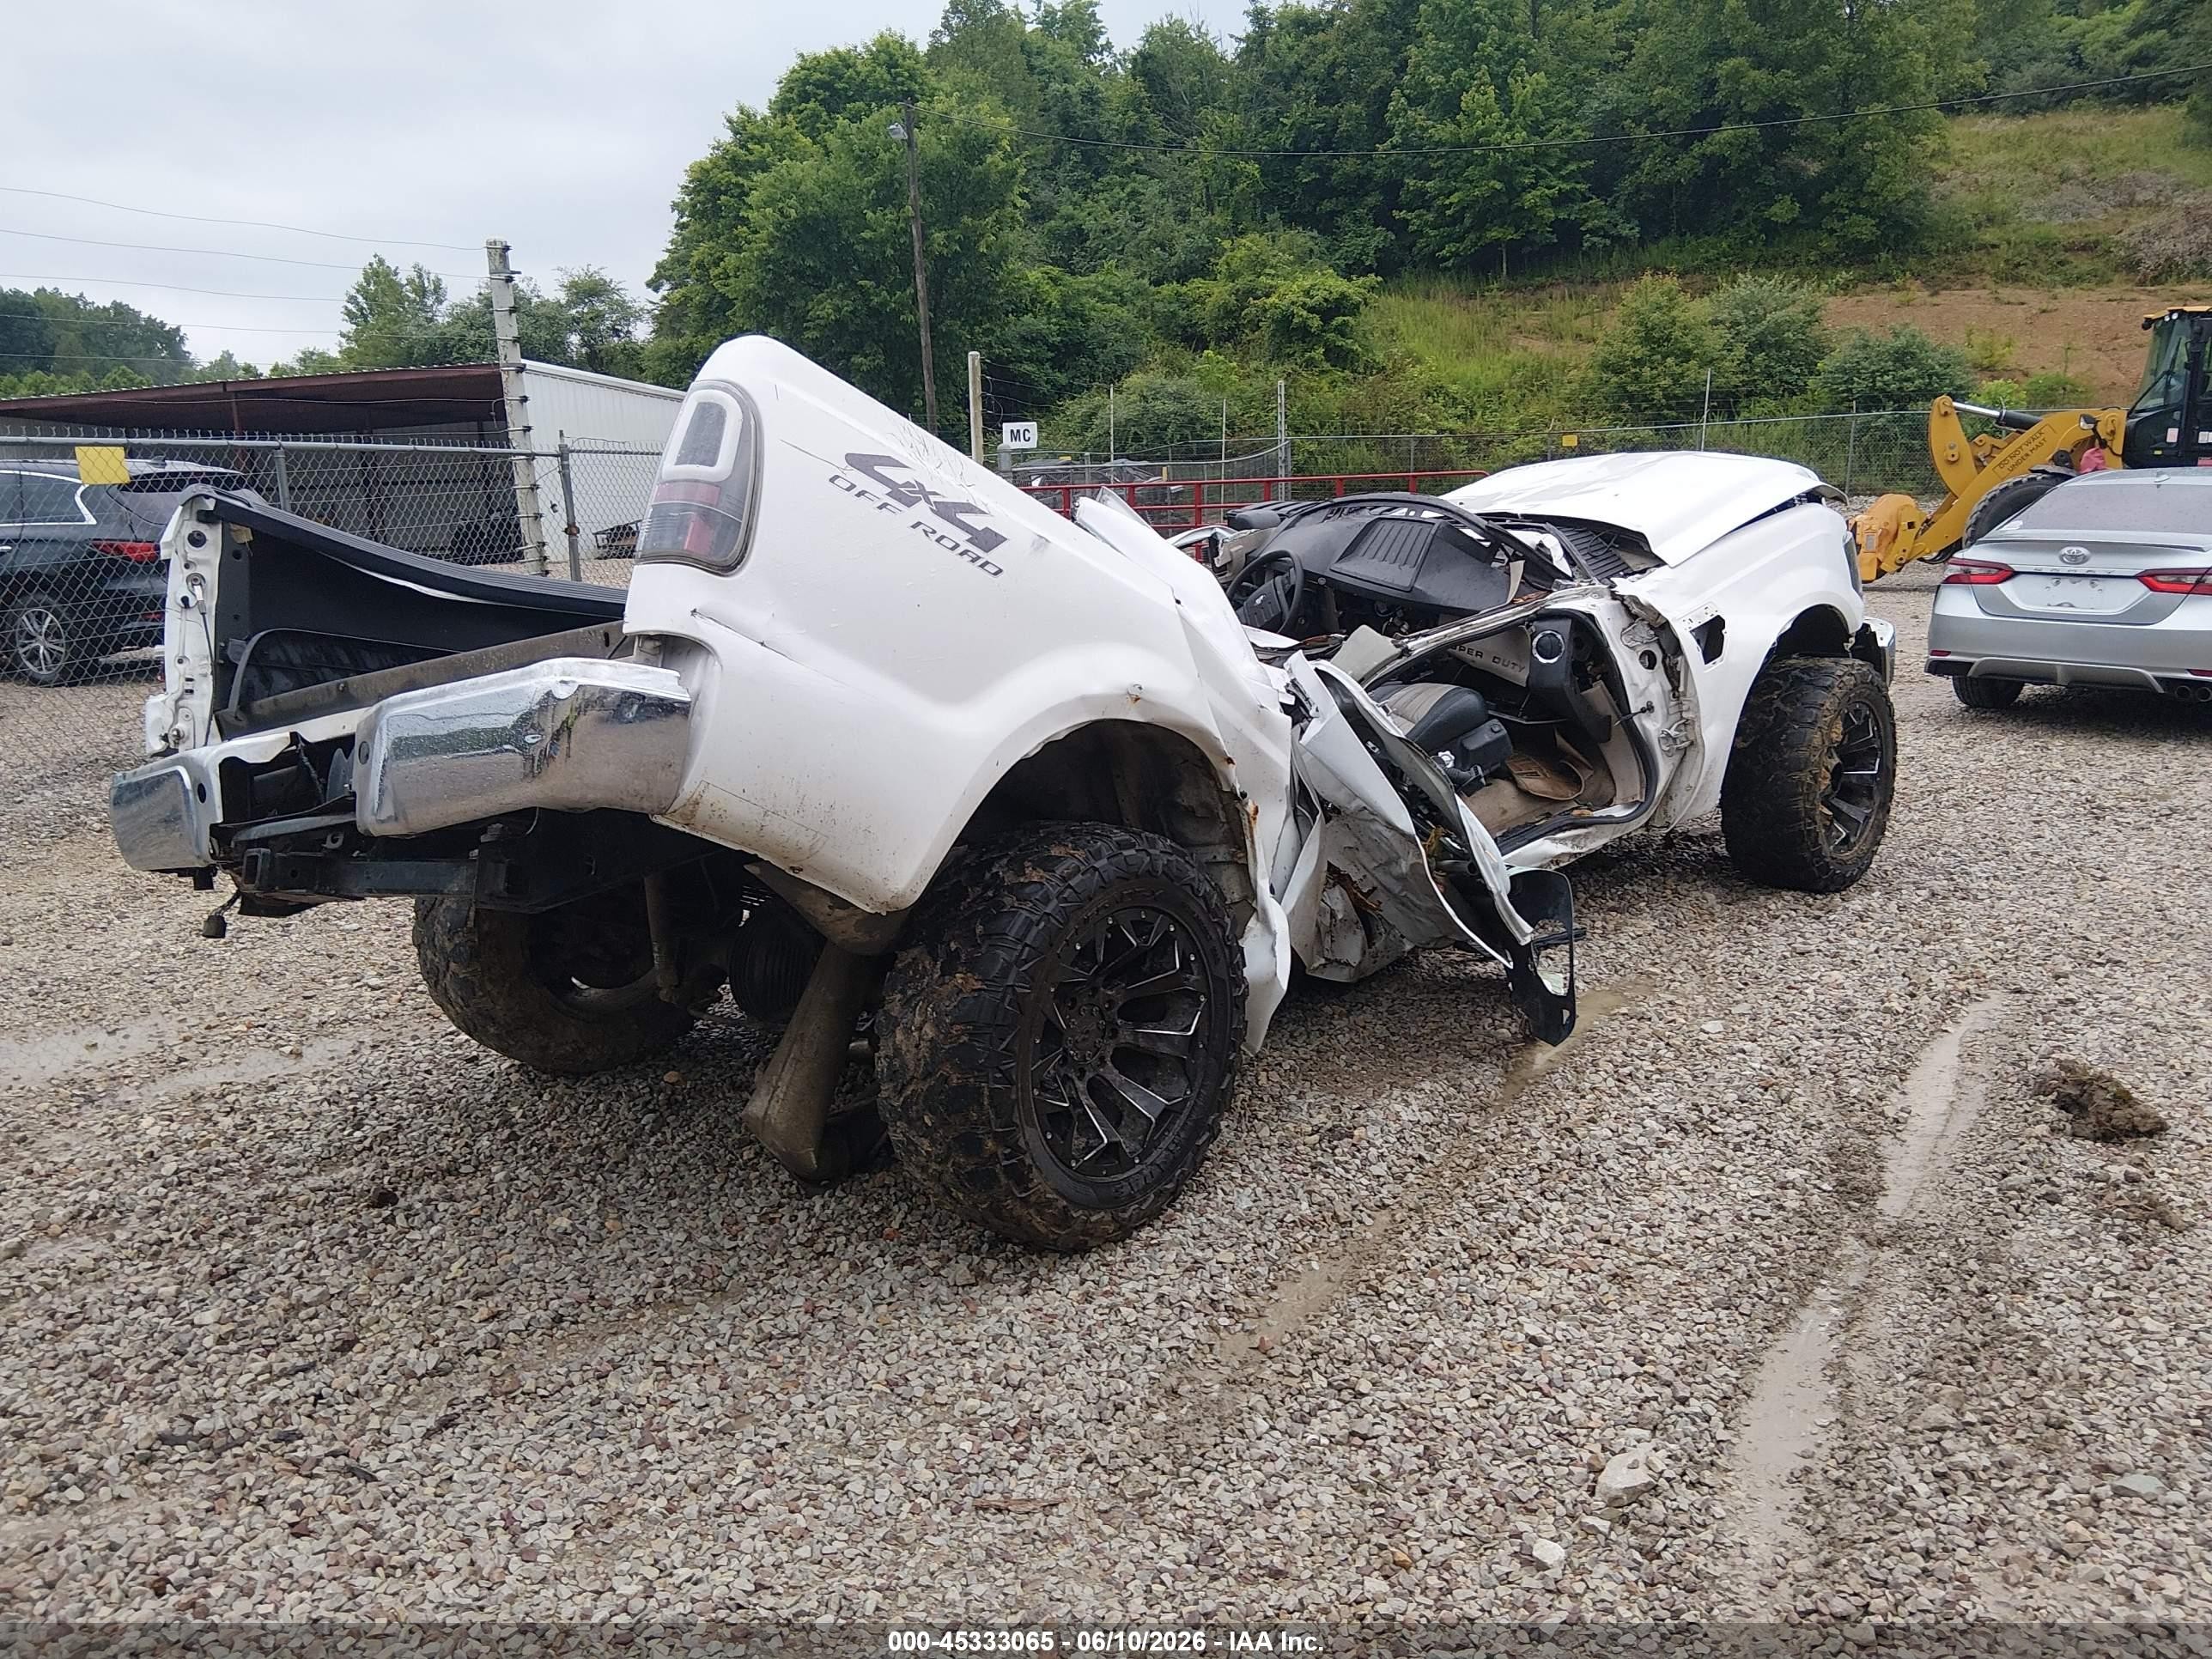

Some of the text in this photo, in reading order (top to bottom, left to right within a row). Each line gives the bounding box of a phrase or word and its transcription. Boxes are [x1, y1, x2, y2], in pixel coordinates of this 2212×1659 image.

[1010, 429, 1031, 443] MC
[1998, 431, 2045, 469] DO NOT WALK
[2008, 437, 2047, 471] UNDER MAST
[829, 474, 1003, 576] OFF ROAD
[1492, 655, 1525, 672] DUTY
